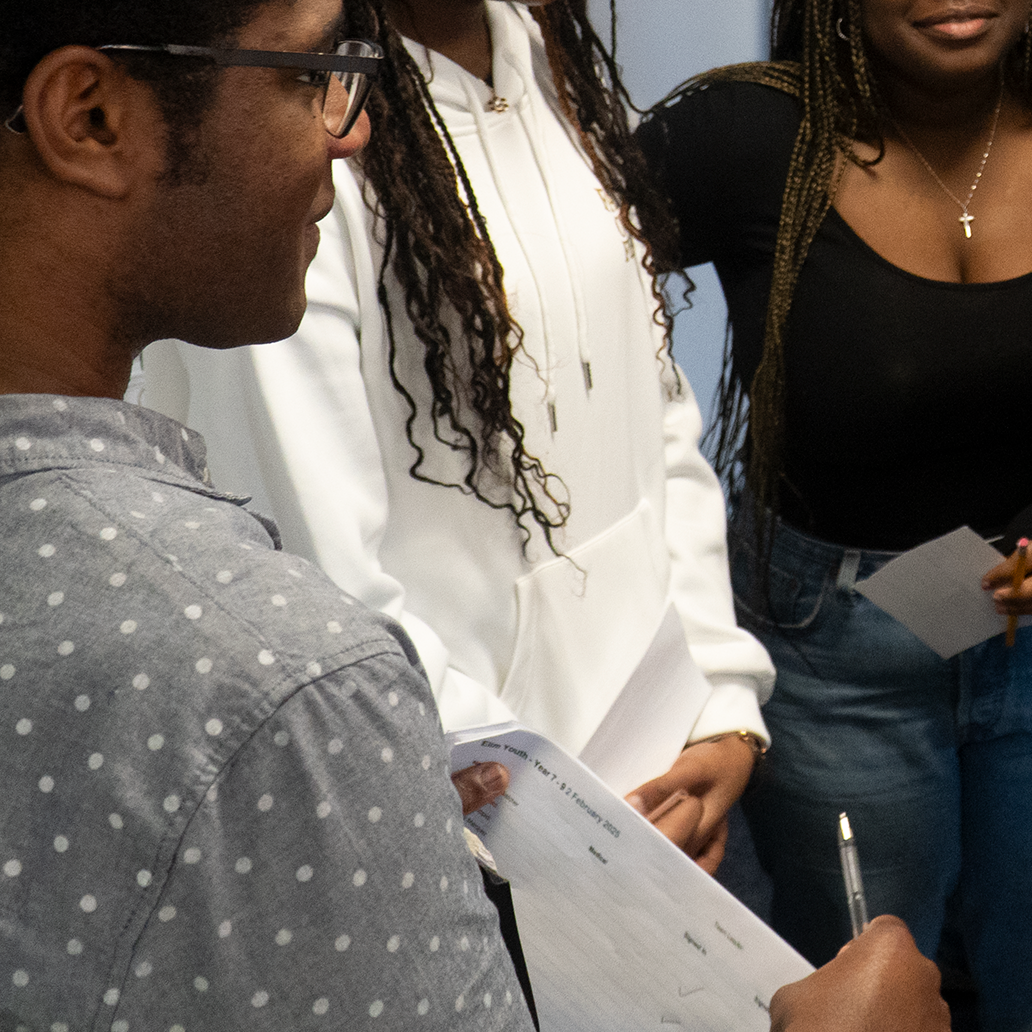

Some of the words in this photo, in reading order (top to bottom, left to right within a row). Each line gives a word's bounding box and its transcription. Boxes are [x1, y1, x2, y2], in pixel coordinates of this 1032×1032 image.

[504, 744, 529, 761] Youth
[534, 759, 551, 777] Year
[571, 792, 603, 824] February
